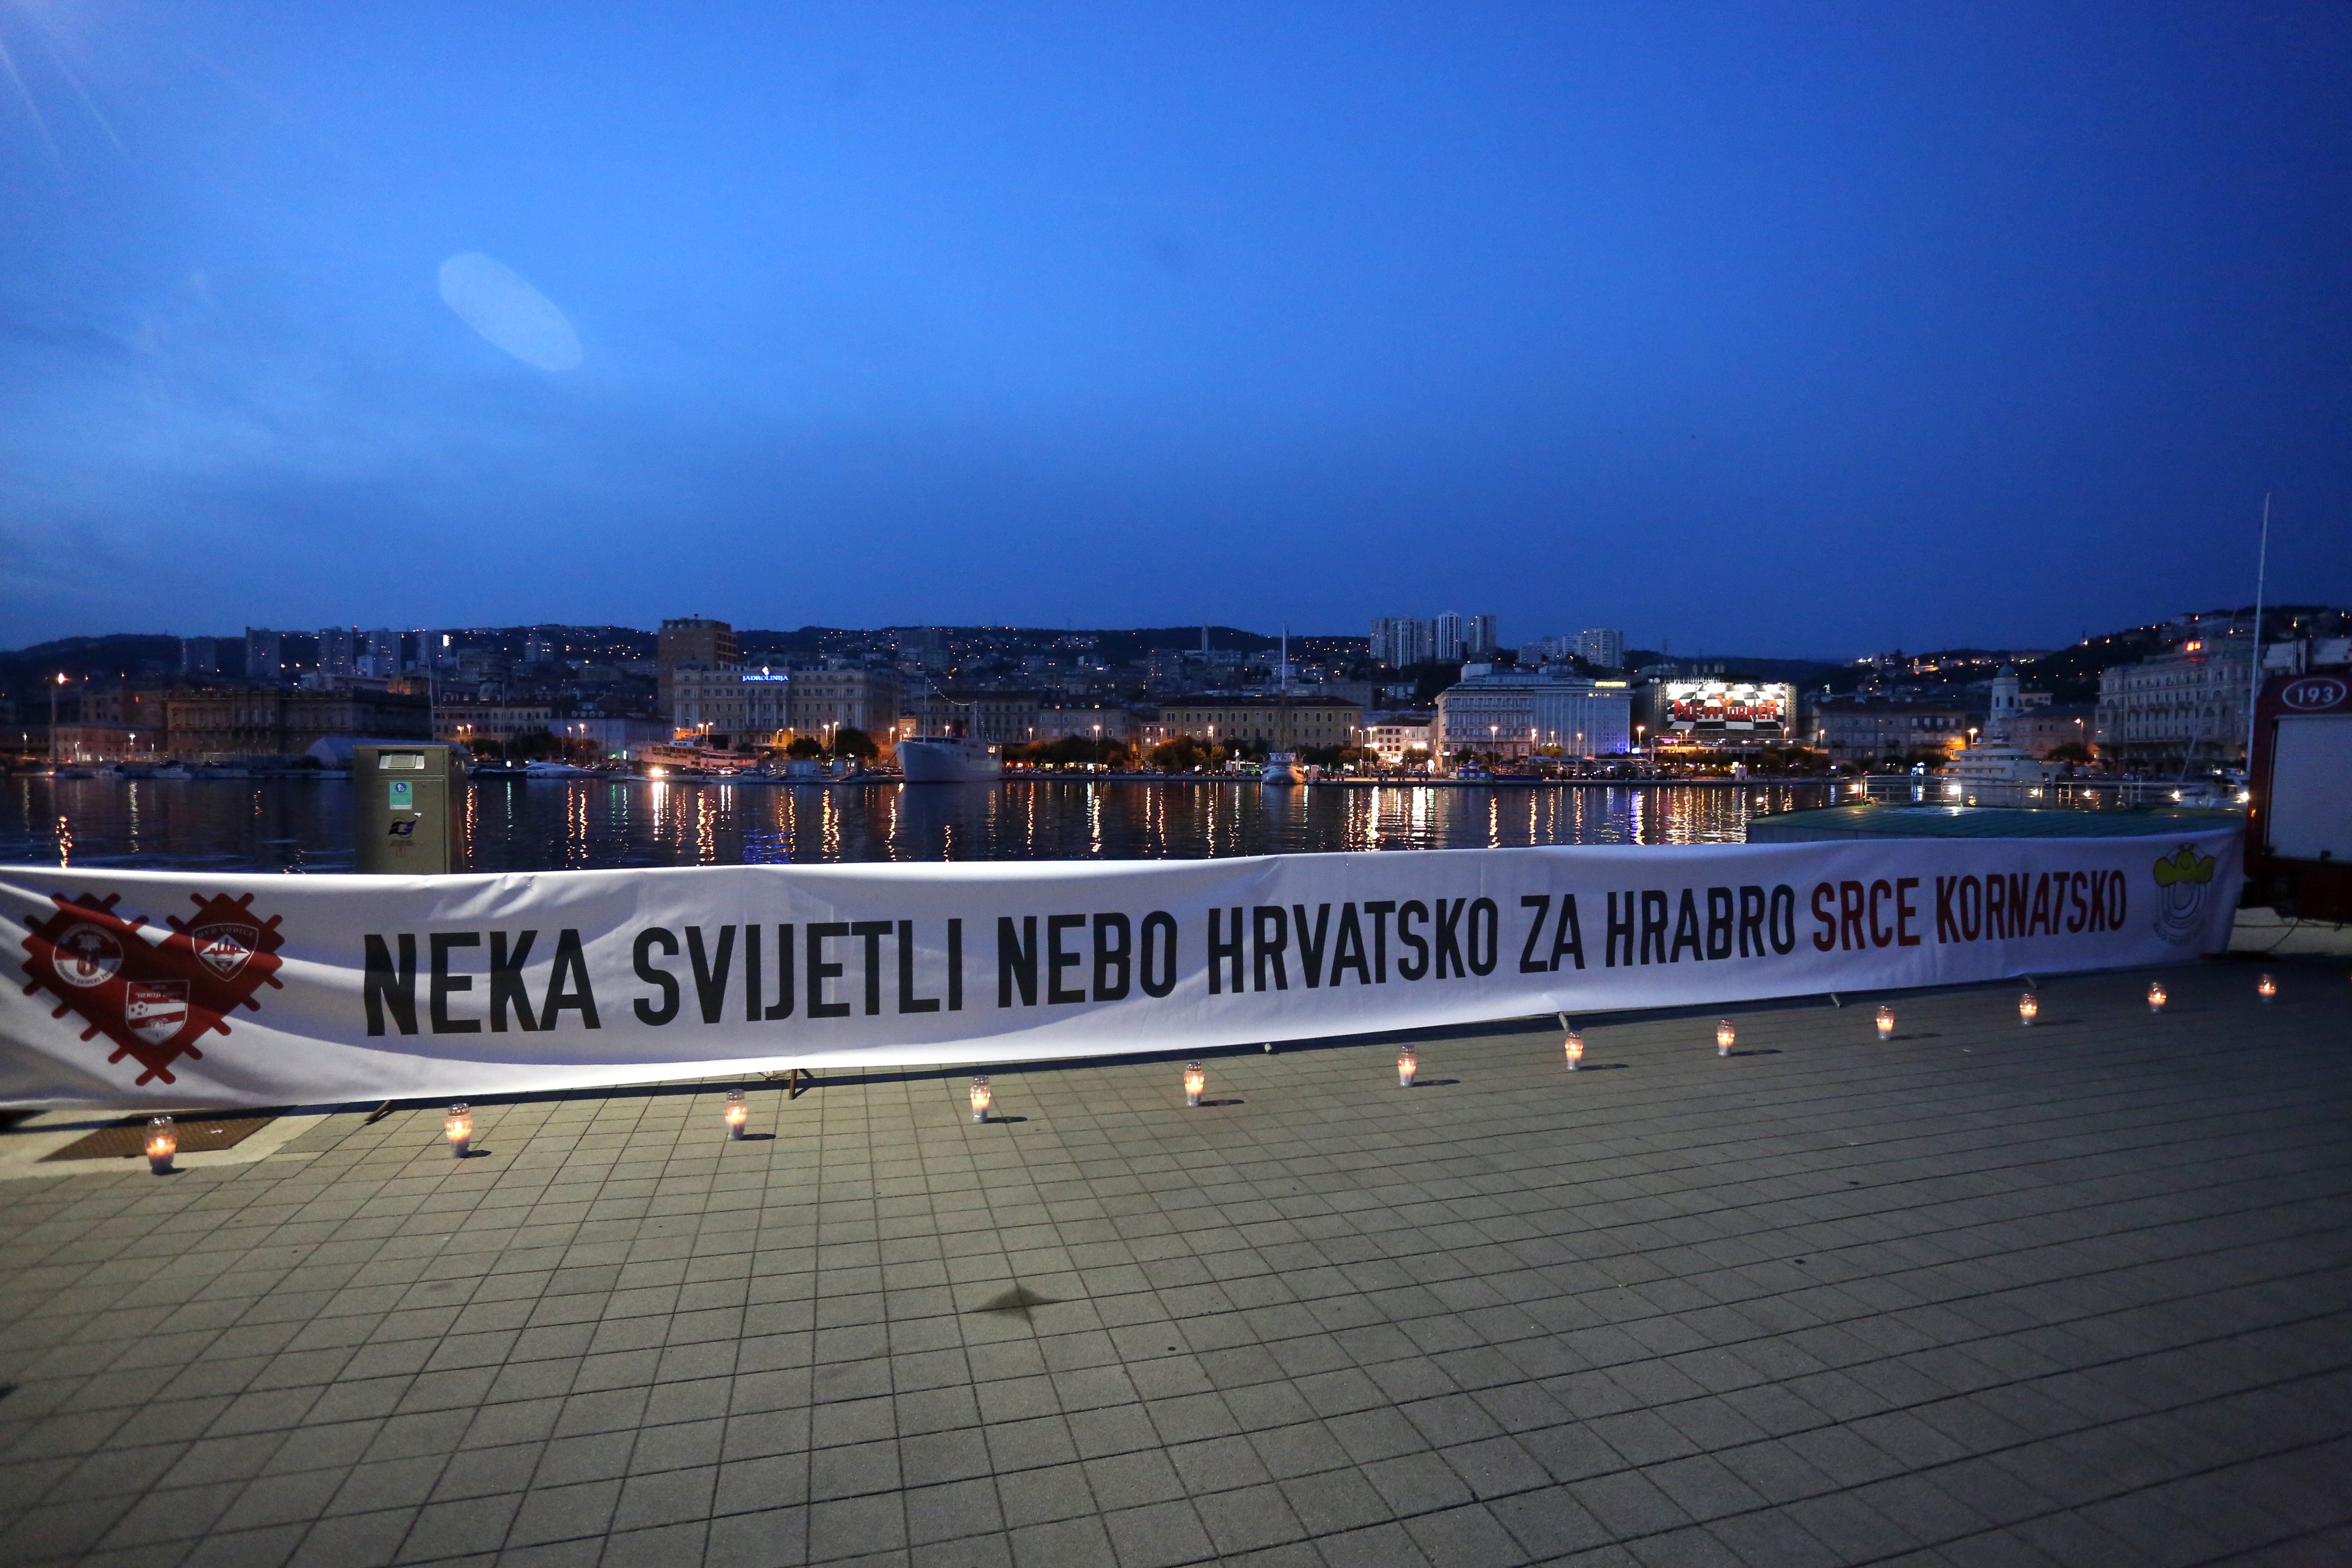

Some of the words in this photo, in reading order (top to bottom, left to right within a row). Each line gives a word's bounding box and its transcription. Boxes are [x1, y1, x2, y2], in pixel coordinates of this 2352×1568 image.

[2297, 687, 2334, 704] 193
[363, 928, 601, 1037] NEKA
[633, 918, 963, 1026] SVIJETLI
[998, 911, 1177, 1008] NEBO
[1207, 897, 1498, 995] HRVATSKO
[1519, 894, 1586, 974] ZA
[1606, 884, 1795, 968] HRABRO
[1810, 878, 1921, 952] SRCE
[1936, 870, 2127, 944] KORNATSKO
